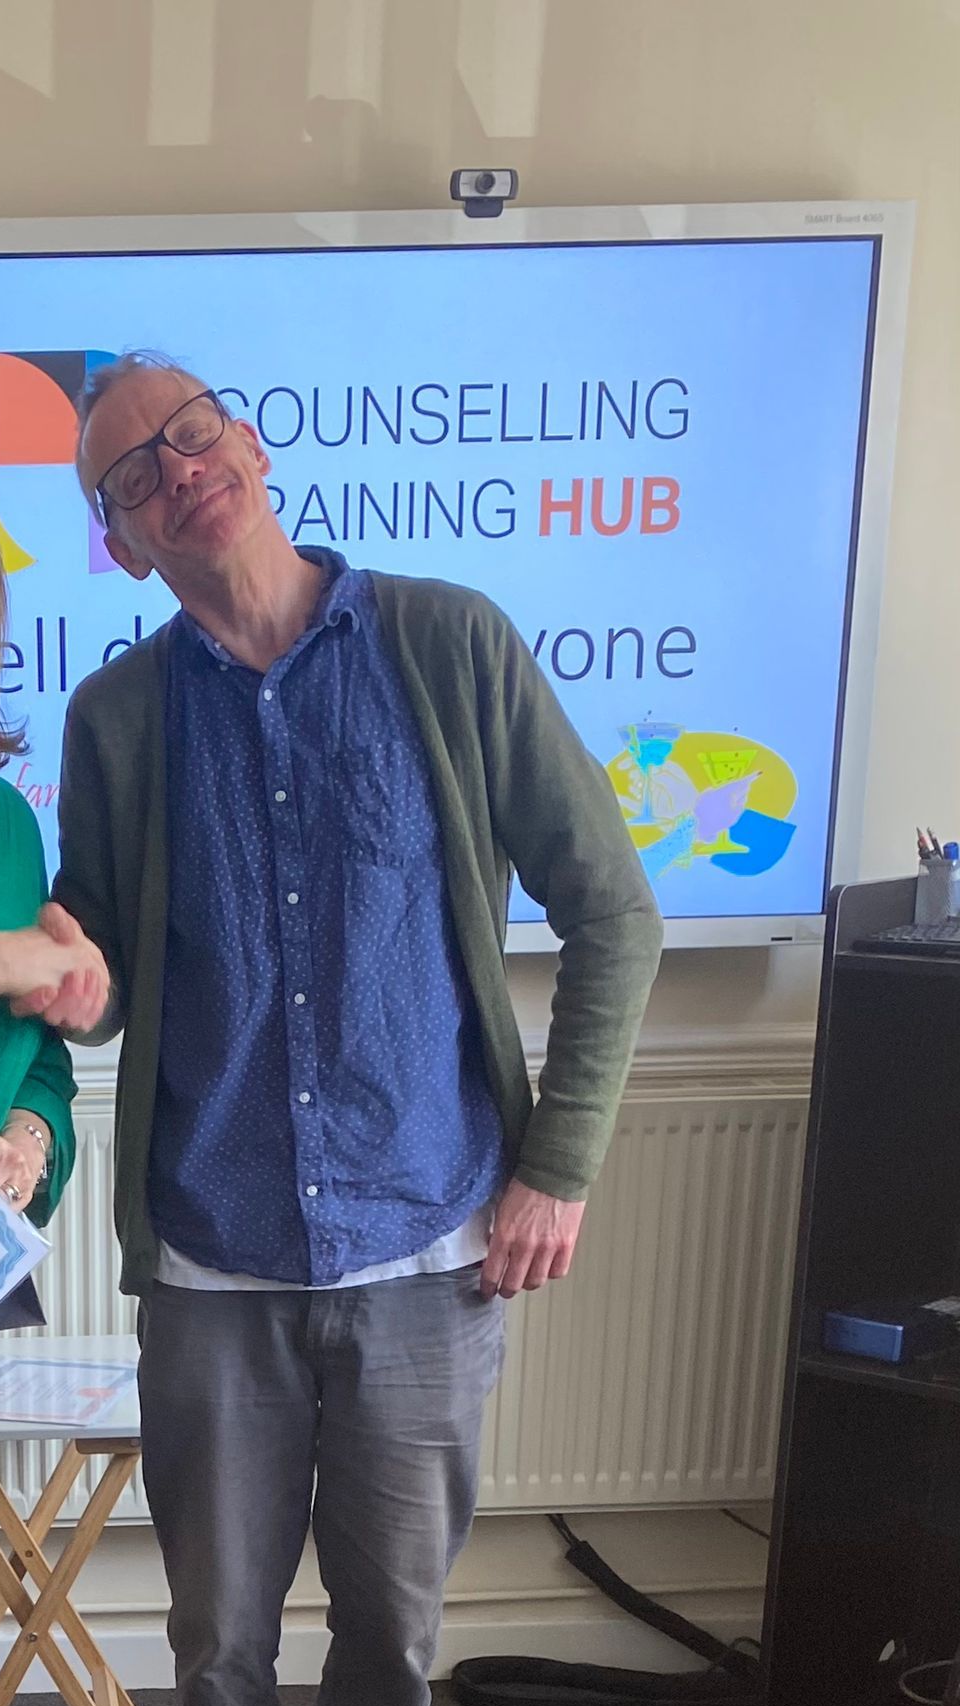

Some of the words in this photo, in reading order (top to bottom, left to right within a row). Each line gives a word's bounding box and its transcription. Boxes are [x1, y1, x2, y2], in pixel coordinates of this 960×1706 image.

[266, 478, 516, 541] AINING
[538, 476, 681, 536] HUB
[532, 626, 696, 680] one
